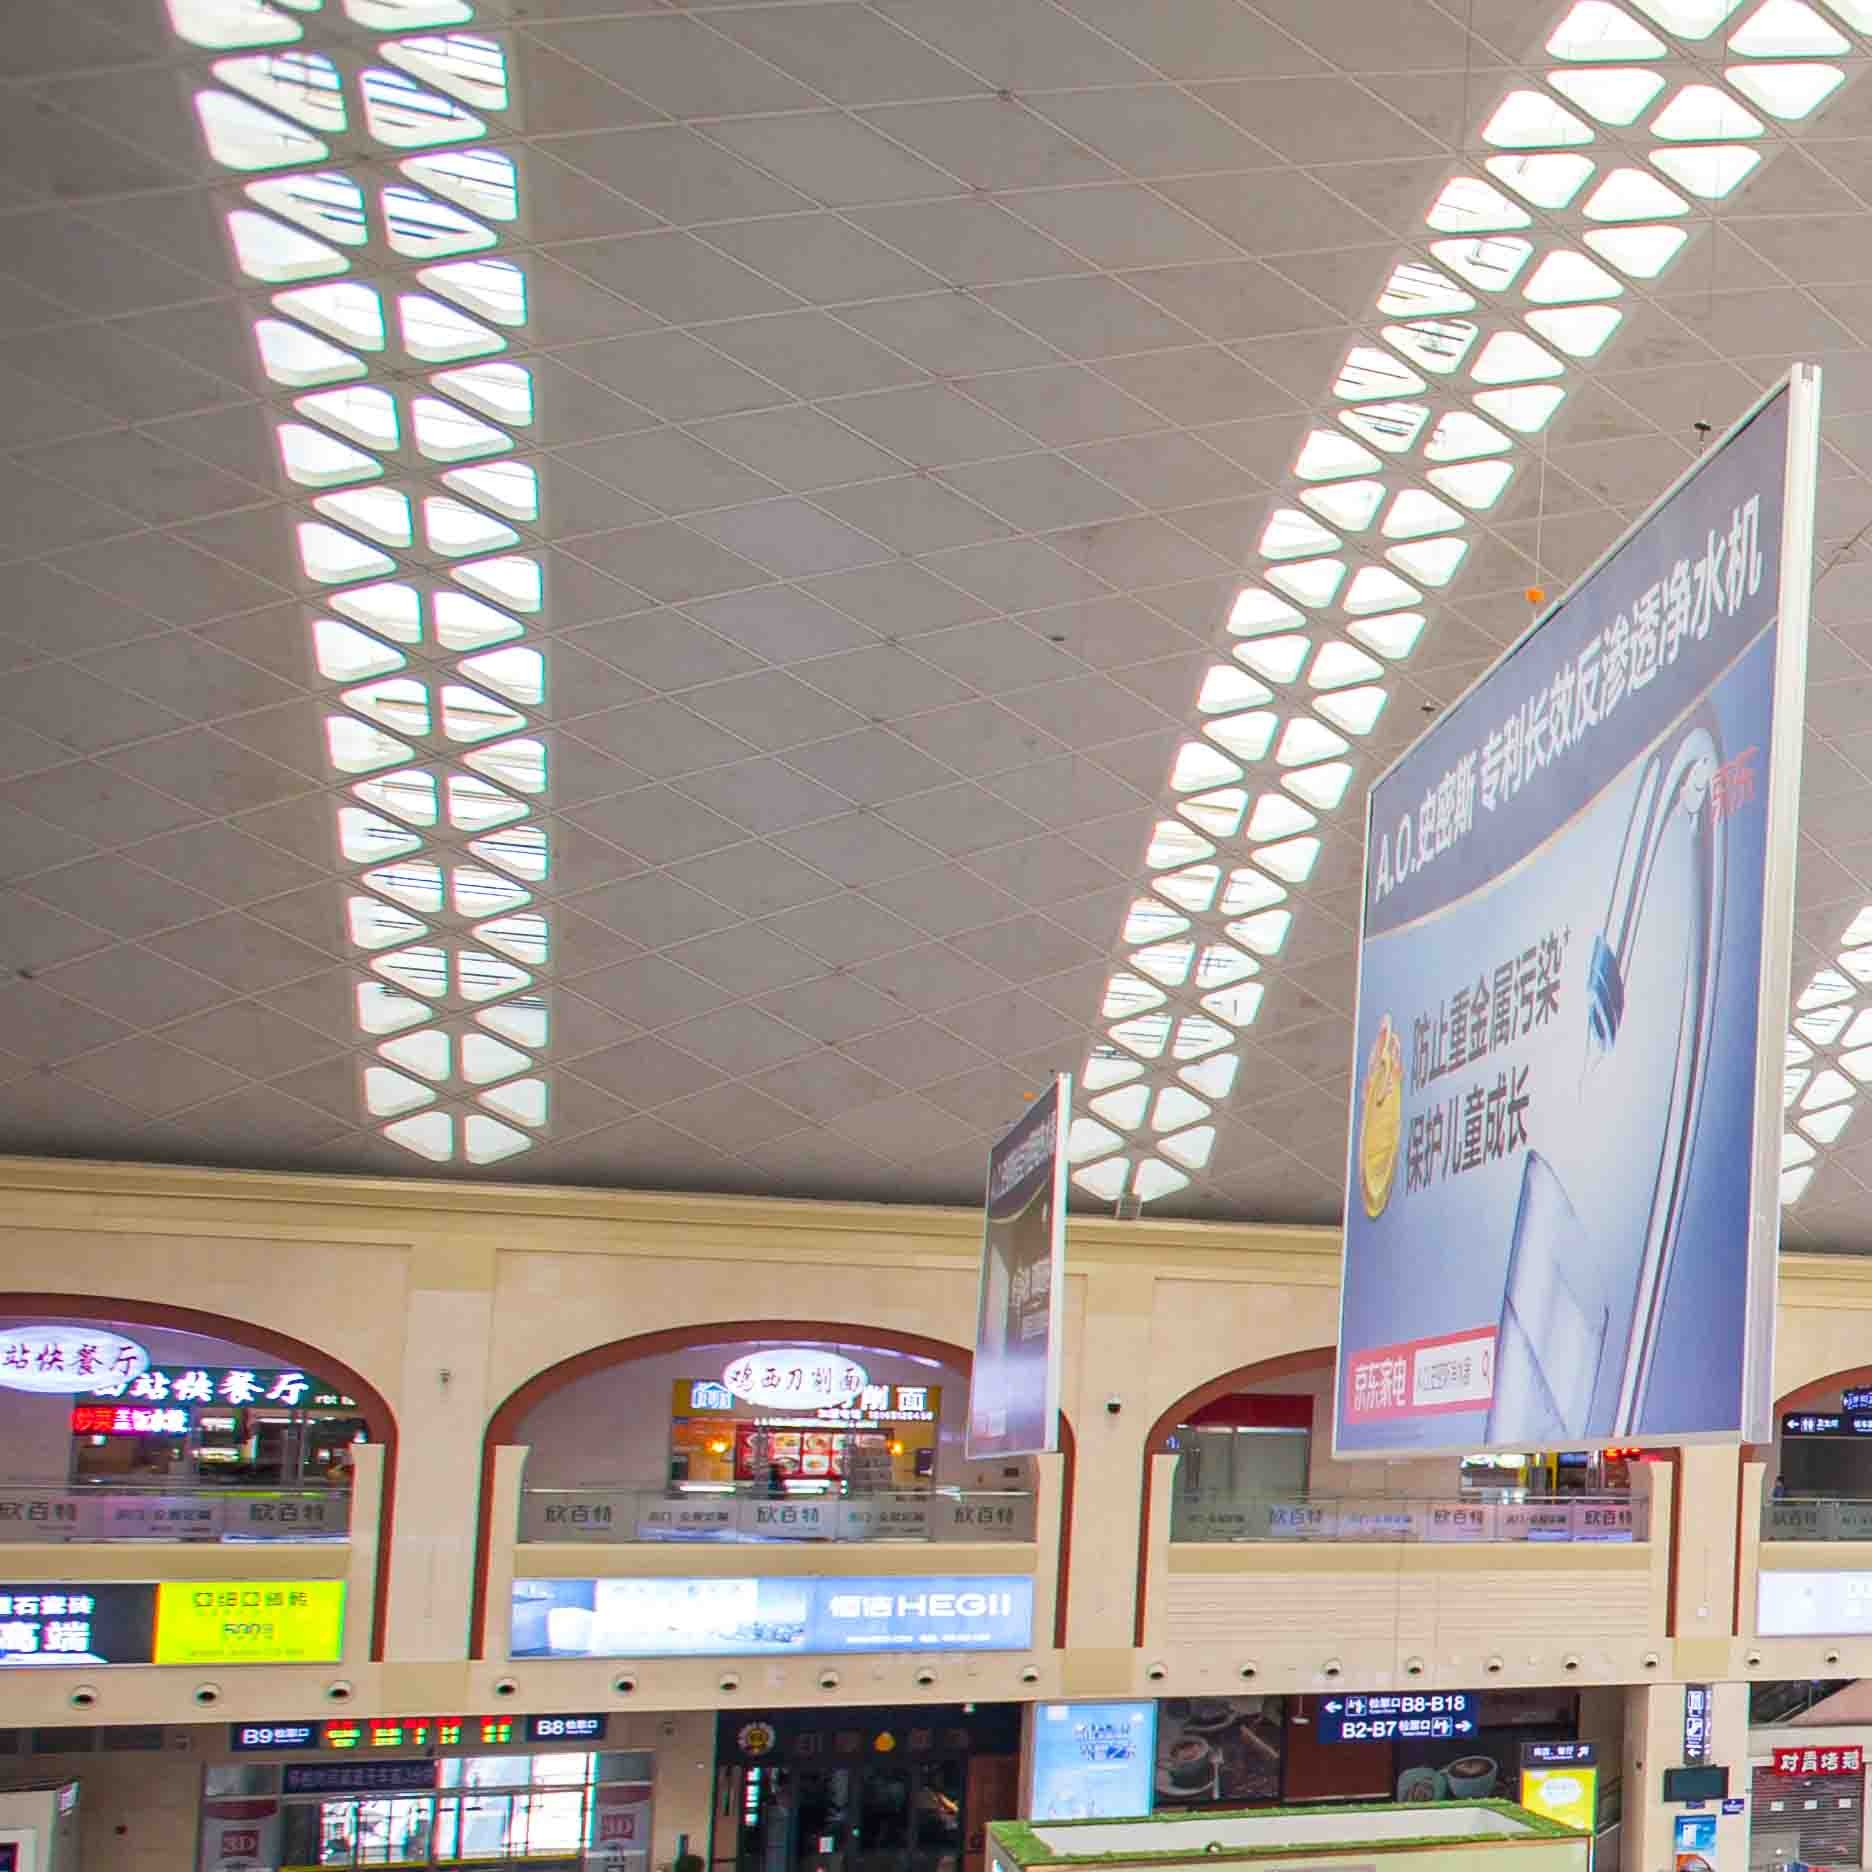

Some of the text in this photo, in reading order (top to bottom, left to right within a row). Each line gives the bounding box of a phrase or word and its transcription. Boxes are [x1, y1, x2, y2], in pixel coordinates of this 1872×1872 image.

[1411, 930, 1562, 1096] 防止重金属污染
[1405, 1064, 1530, 1197] 保护儿童成长
[729, 1366, 862, 1395] 鸡西刀削面
[895, 1594, 1010, 1618] HEGII
[1401, 1696, 1466, 1712] B8-B18
[243, 1728, 272, 1746] B9
[537, 1719, 565, 1736] B8
[1342, 1721, 1397, 1739] B2-B7
